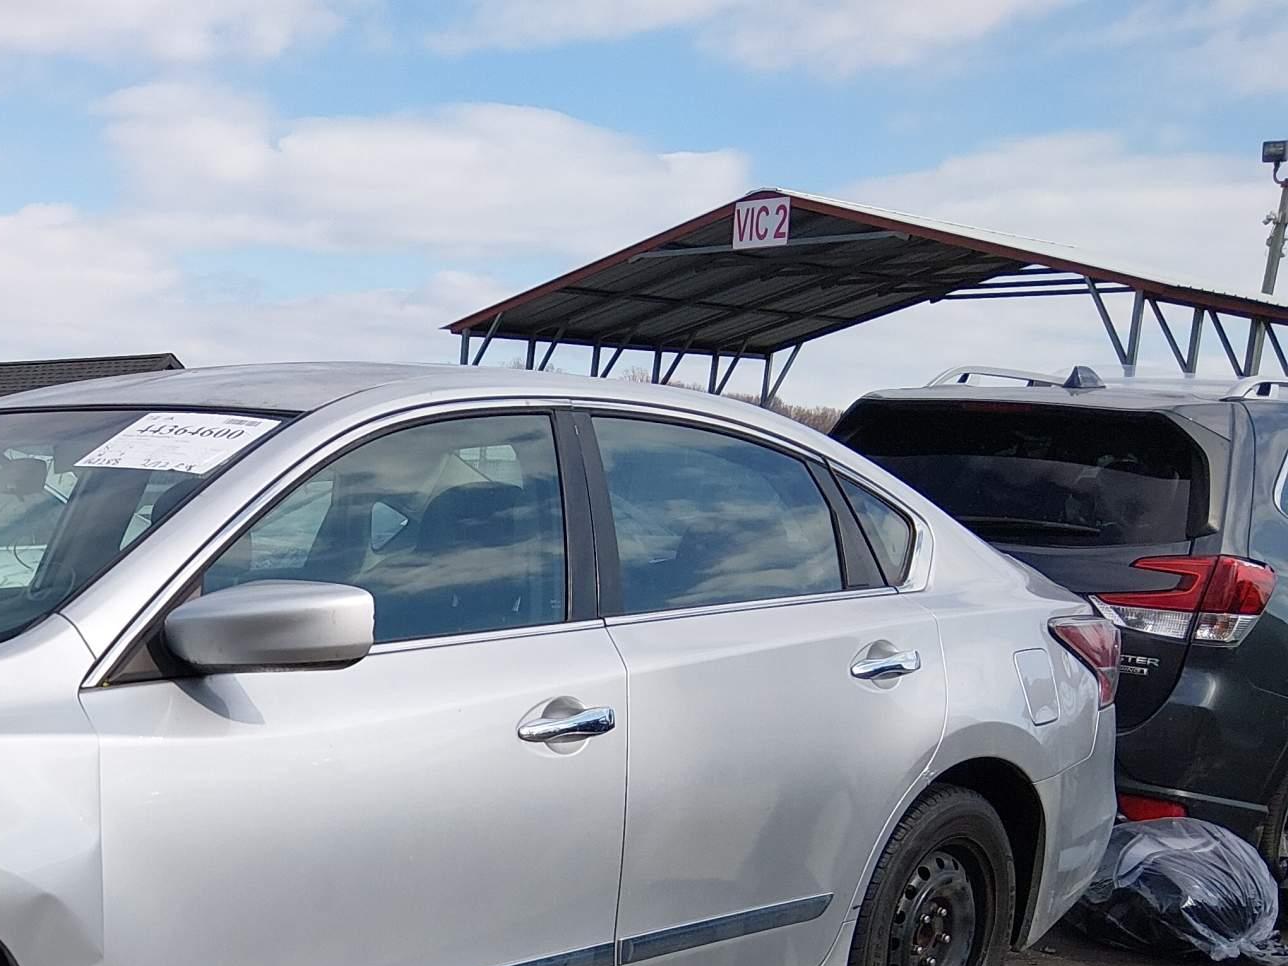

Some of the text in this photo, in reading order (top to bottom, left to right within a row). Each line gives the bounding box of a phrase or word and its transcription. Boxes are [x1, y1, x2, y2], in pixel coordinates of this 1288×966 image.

[737, 204, 788, 242] VIC 2
[136, 424, 245, 440] 44364600
